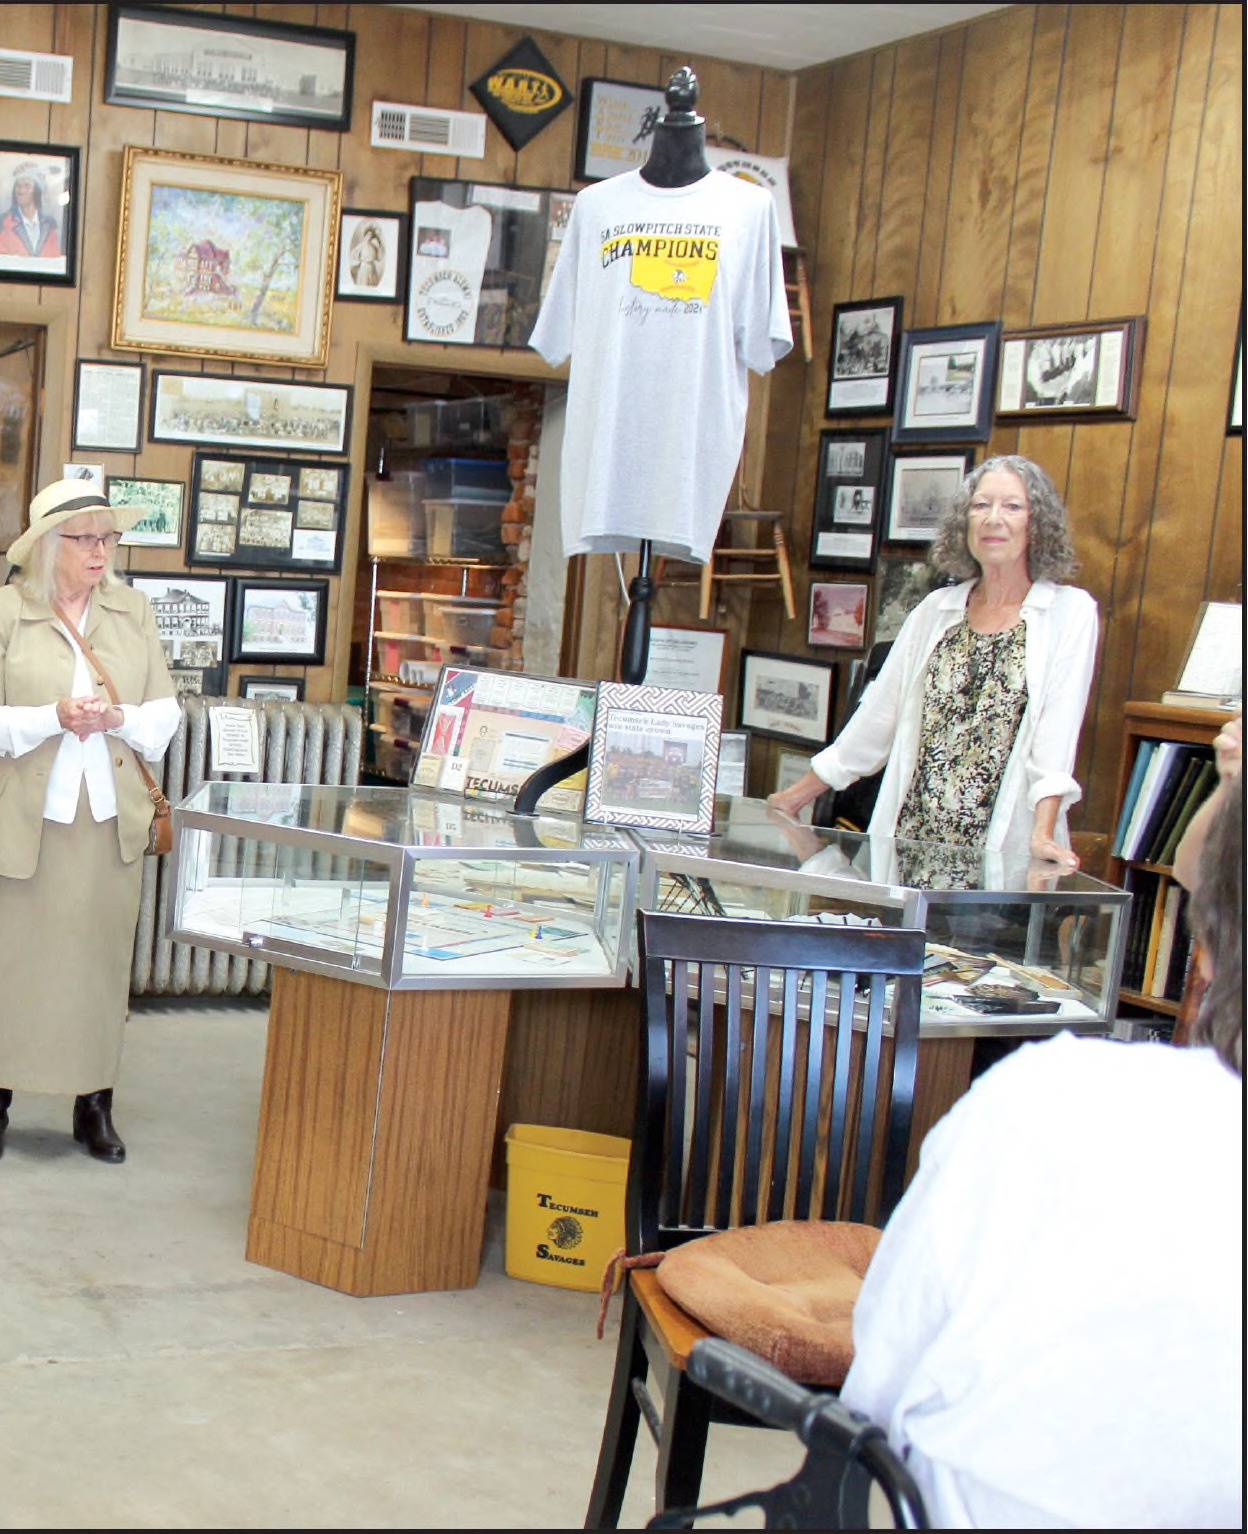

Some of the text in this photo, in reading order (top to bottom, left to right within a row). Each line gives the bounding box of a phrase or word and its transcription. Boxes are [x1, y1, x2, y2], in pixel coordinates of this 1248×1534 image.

[613, 222, 683, 237] SLOWPITCH
[684, 223, 722, 237] STATE
[602, 239, 718, 269] CHAMPIONS
[537, 1193, 598, 1217] TECUMSEH
[536, 1244, 585, 1266] SAVAGES
